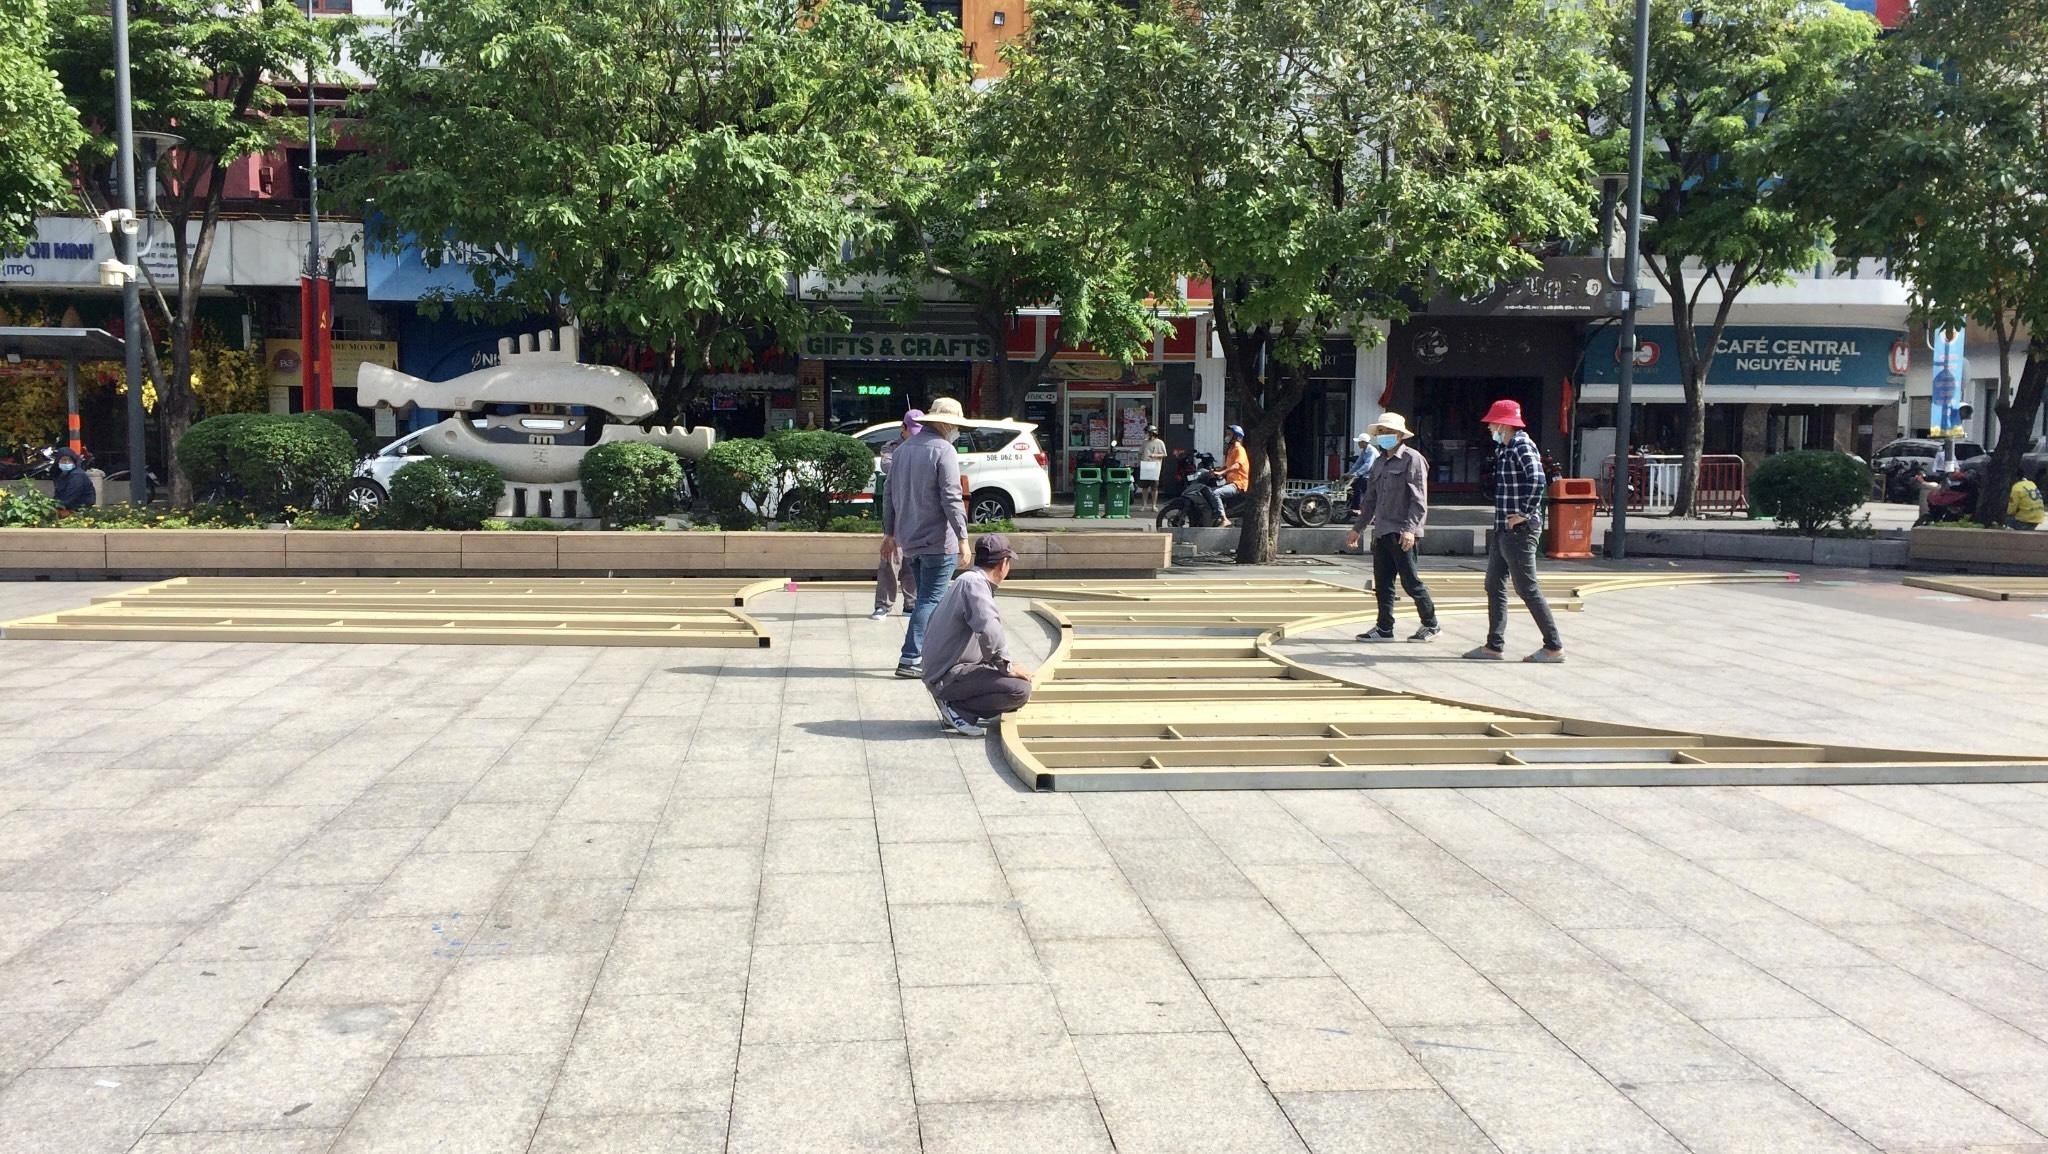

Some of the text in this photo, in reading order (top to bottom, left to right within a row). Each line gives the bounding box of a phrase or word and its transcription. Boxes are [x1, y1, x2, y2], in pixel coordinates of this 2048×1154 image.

[53, 243, 94, 260] MINH
[3, 264, 35, 277] (ITPC)
[806, 336, 991, 357] GIFTS & CRAFTS
[1715, 336, 1861, 356] CAFÉ CENTRAL
